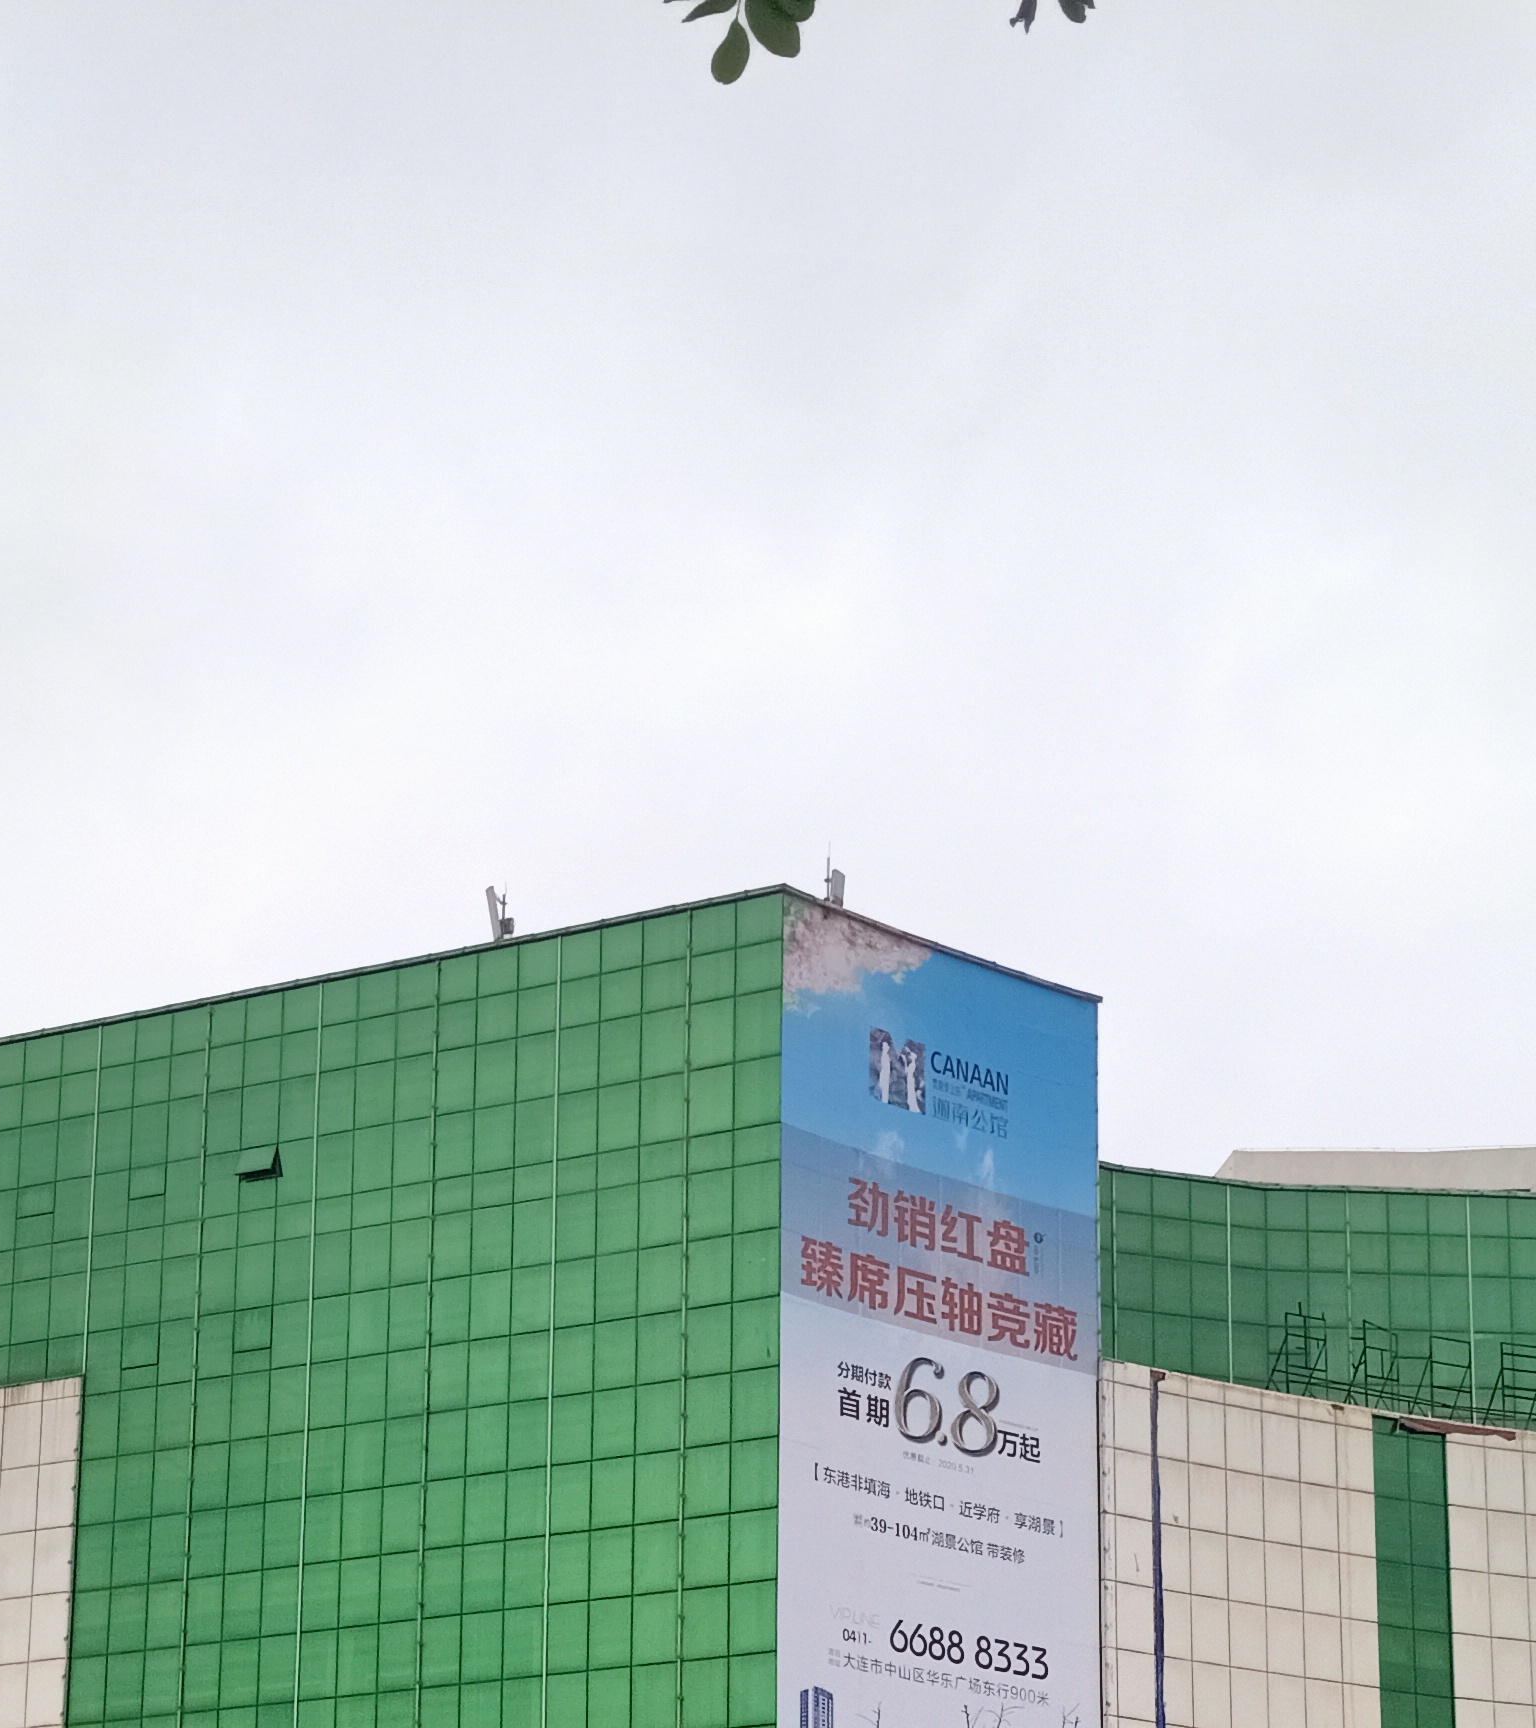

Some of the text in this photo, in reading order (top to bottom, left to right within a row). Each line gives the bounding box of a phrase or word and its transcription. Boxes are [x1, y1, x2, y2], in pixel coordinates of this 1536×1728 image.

[931, 1051, 1009, 1095] CANAAN
[932, 1095, 1009, 1139] 迦南公馆
[848, 1176, 1030, 1277] 劲销红盘
[800, 1235, 1079, 1361] 臻席压轴竞藏
[837, 1360, 892, 1390] 分期付款
[837, 1356, 1042, 1464] 首期 6.8 万起
[889, 1619, 965, 1664] 6688
[974, 1635, 1049, 1680] 8333
